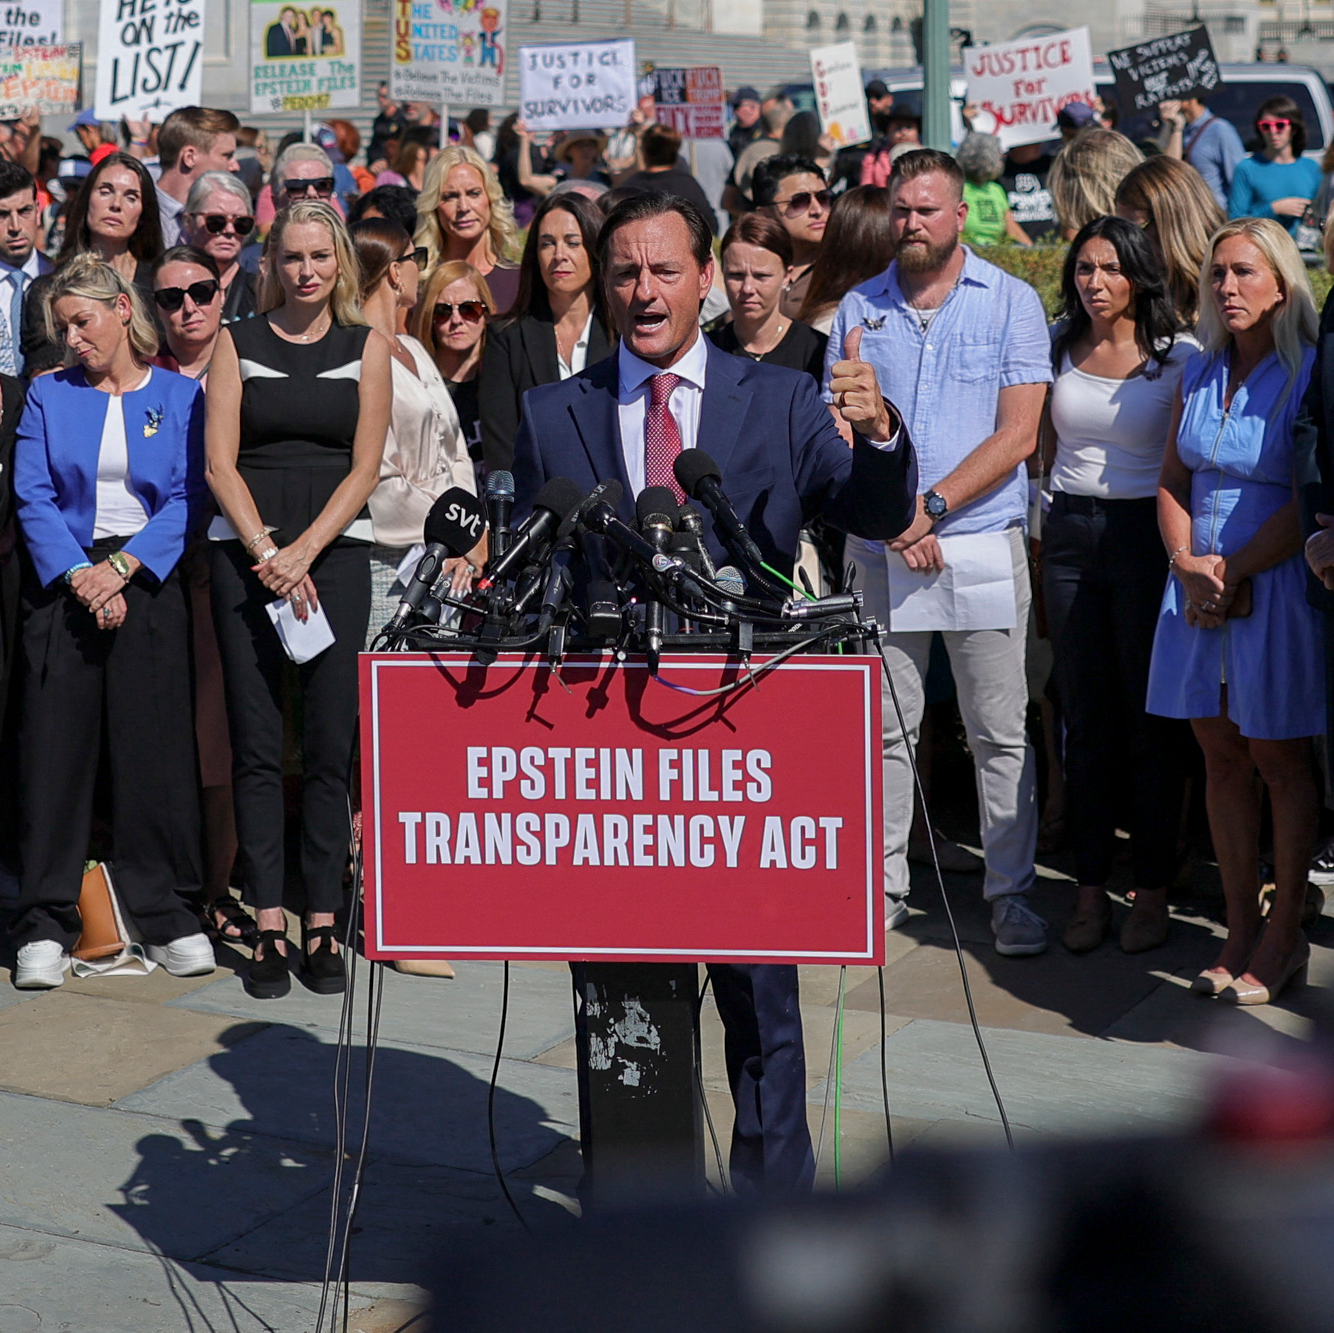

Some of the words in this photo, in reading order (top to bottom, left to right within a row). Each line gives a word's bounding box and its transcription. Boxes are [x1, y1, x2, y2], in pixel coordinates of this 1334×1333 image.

[5, 7, 41, 27] the
[120, 15, 156, 48] ON
[164, 7, 201, 35] the
[110, 40, 203, 105] LIST!
[971, 38, 1073, 78] JUSTICE
[553, 73, 597, 90] FOR
[524, 94, 628, 119] SURVIVORS
[445, 503, 481, 538] svt
[466, 745, 644, 801] EPSTEIN
[658, 747, 773, 803] FILES
[398, 811, 746, 868] TRANSPARENCY
[758, 814, 843, 870] ACT
